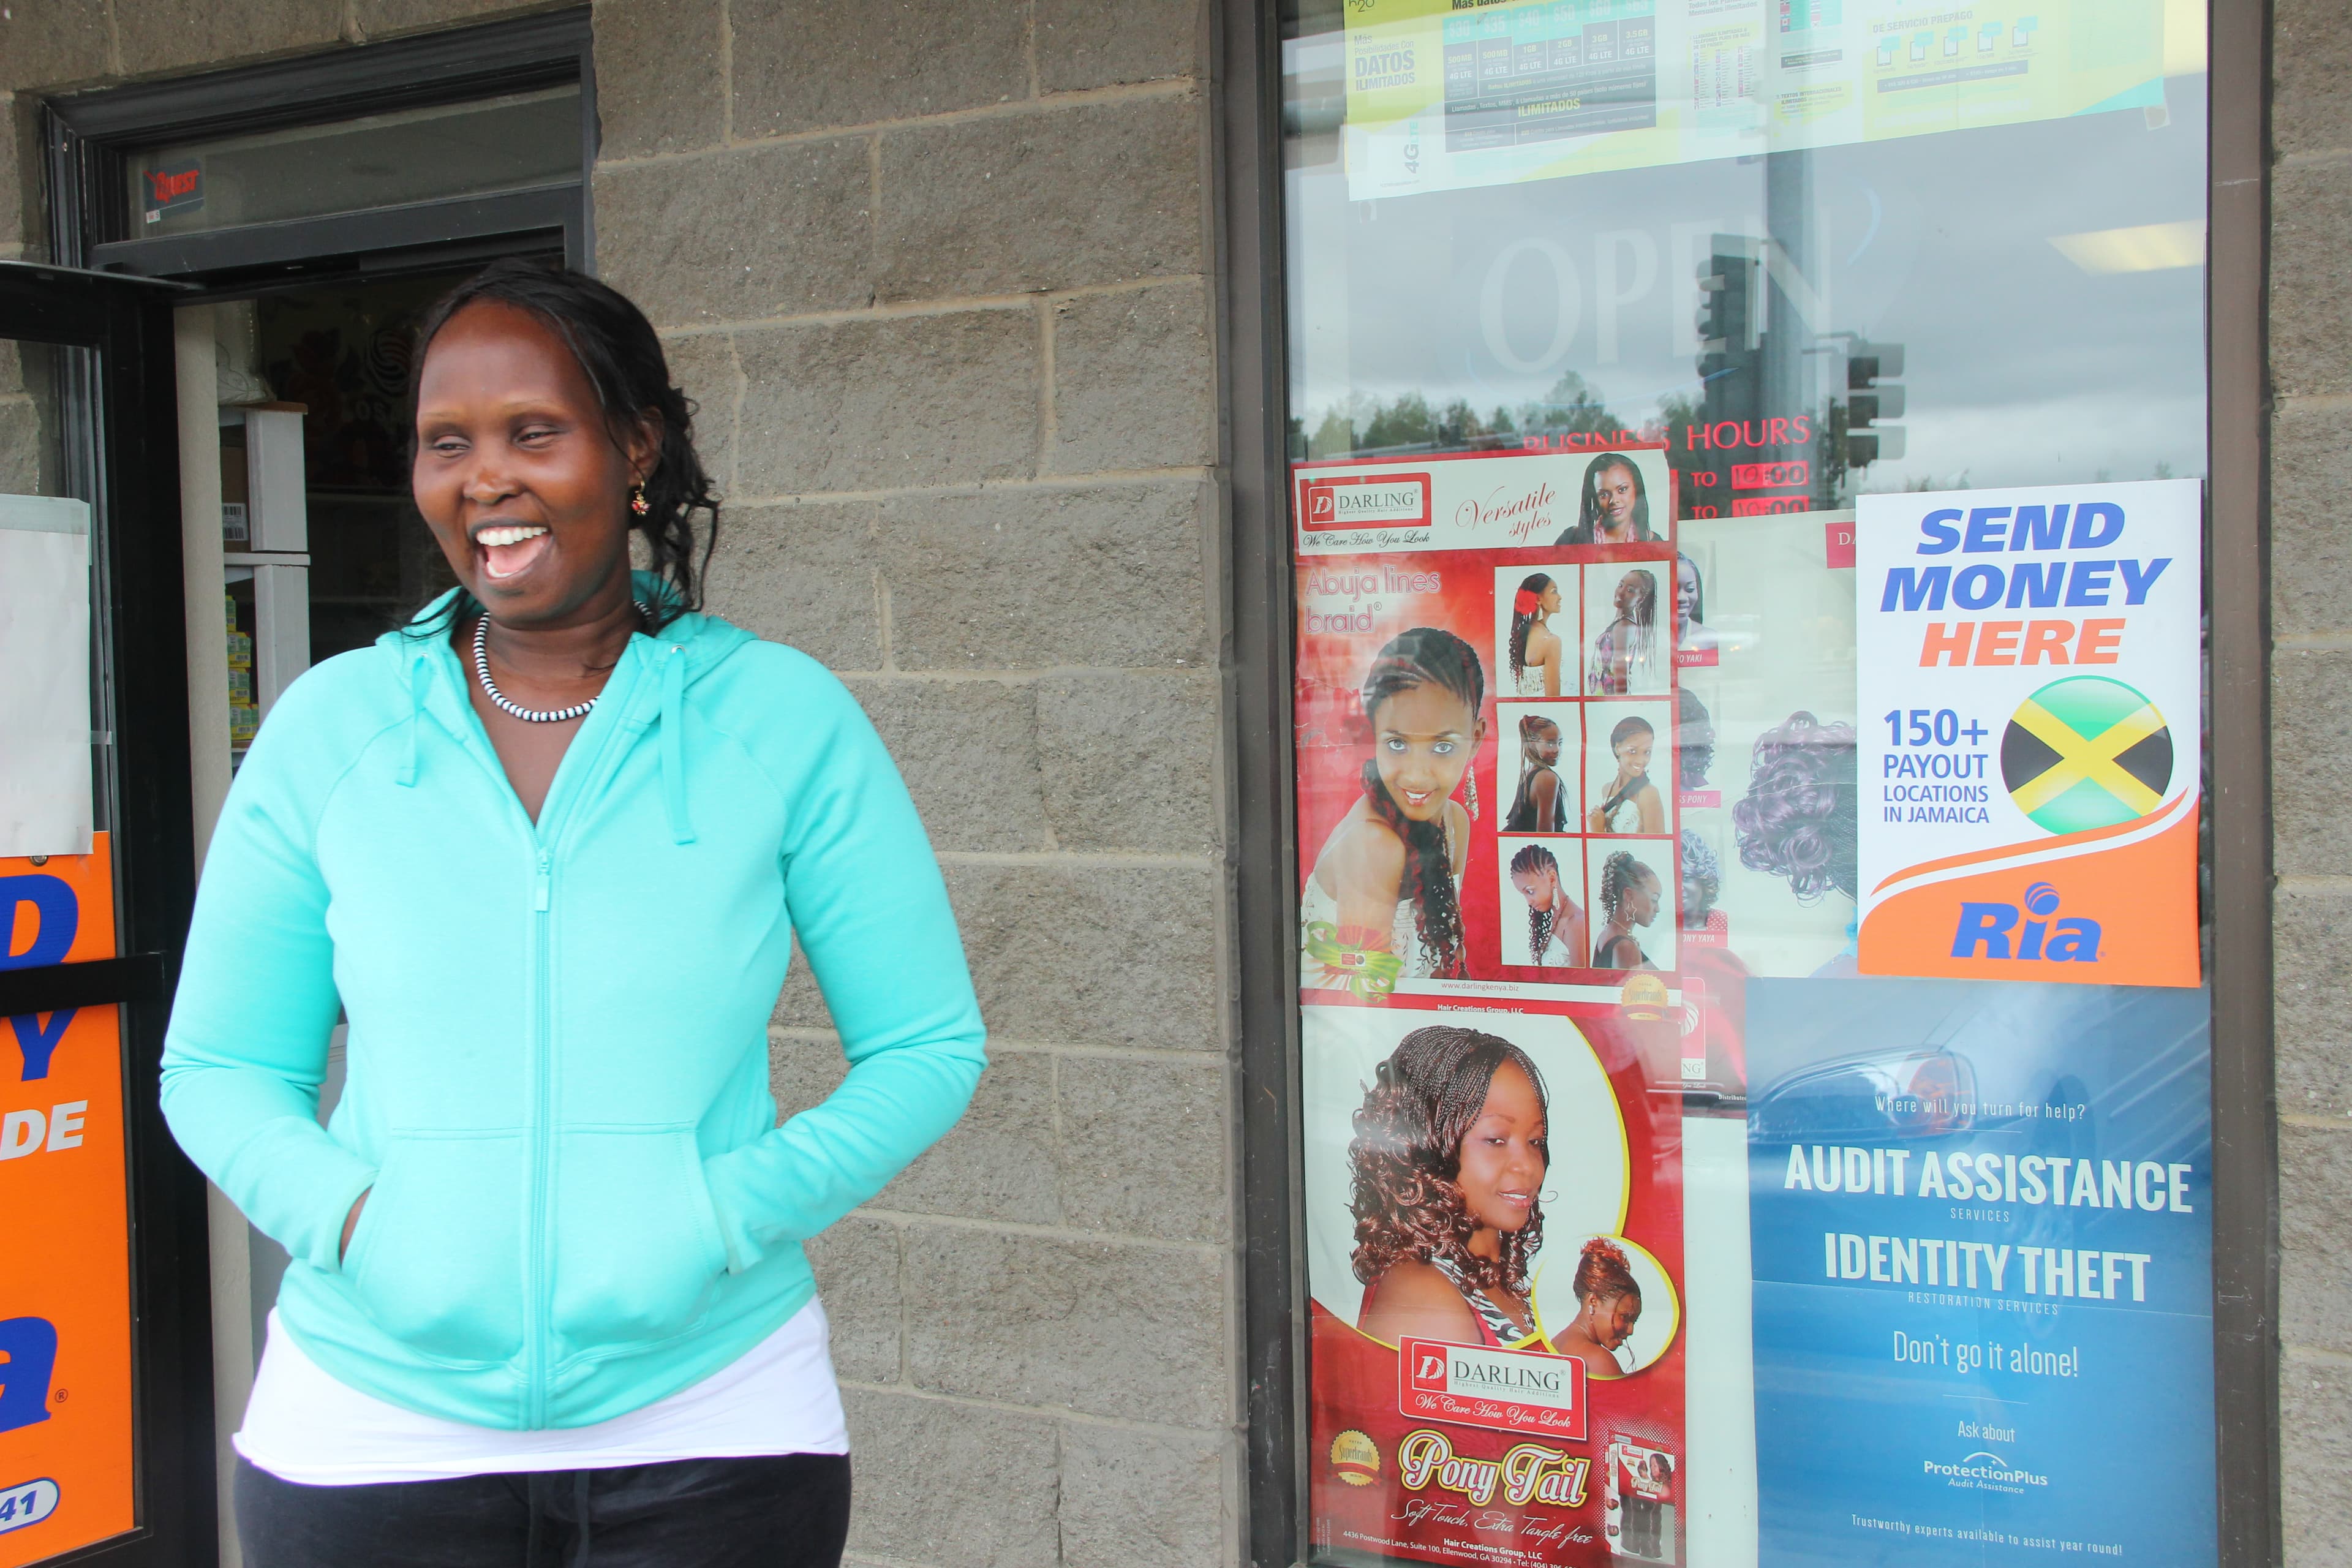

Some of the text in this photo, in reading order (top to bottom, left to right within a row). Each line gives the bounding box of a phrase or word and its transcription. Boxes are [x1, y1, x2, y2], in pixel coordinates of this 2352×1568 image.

[1873, 10, 1973, 33] DE SERVICIO PREPAGO
[1355, 43, 1400, 56] Posibilidades
[1565, 56, 1577, 64] LTE
[1637, 45, 1649, 54] LTE
[1355, 49, 1415, 78] DATOS
[1355, 72, 1415, 91] ILIMITADOS
[1518, 98, 1581, 118] ILIMITADOS
[1479, 208, 1833, 372] OPEN
[1687, 416, 1811, 451] HOURS
[1691, 464, 1805, 487] TO 10:00
[1455, 483, 1556, 531] Versatile
[1692, 505, 1718, 519] TO
[1303, 530, 1430, 548] We Care How You Look
[1509, 510, 1551, 546] styles
[1916, 502, 2125, 556] SEND
[1306, 564, 1441, 602] Abuja lines
[1880, 557, 2174, 612] MONEY
[1918, 617, 2127, 667] HERE
[1883, 709, 1989, 747] 150+
[1883, 753, 1989, 779] PAYOUT
[1687, 794, 1708, 804] PONY
[1883, 785, 1989, 802] LOCATIONS
[1883, 806, 1990, 823] IN JAMAICA
[1950, 881, 2102, 963] Ria
[1698, 933, 1715, 943] YAYA
[1441, 982, 1520, 992] www.darlingkenya.biz
[1875, 1096, 2086, 1122] Where will you turn for help?
[1784, 1144, 2193, 1213] AUDIT ASSISTANCE
[1950, 1208, 2010, 1223] SERVICES
[1825, 1232, 2150, 1302] IDENTITY THEFT
[1908, 1291, 2059, 1315] RESTORATION SERVICES
[1893, 1330, 2078, 1377] Don't go it alone!
[1481, 1384, 1506, 1392] Quality
[1526, 1389, 1559, 1398] Additions
[1415, 1393, 1571, 1428] We Care How You Look
[1958, 1420, 2015, 1443] Ask about
[1338, 1444, 1373, 1463] Superbrands
[1399, 1430, 1591, 1507] Pony Tail
[1923, 1460, 2048, 1486] ProtectionPlus
[1948, 1478, 2024, 1494] Audit Assistance
[1390, 1499, 1593, 1549] Soft Touch, Extra Tangle free
[1852, 1514, 2122, 1556] Trustworthy experts available to assist year round!
[1343, 1531, 1359, 1539] 4436
[1360, 1533, 1390, 1545] Postwood
[1391, 1539, 1409, 1549] Lane,
[1410, 1542, 1427, 1551] Suite
[1428, 1545, 1441, 1554] 100,
[1442, 1547, 1479, 1560] Ellenwood,
[1480, 1553, 1490, 1561] GA
[1491, 1555, 1512, 1564] 30294
[1517, 1559, 1529, 1568] Tel:
[1444, 1538, 1542, 1560] Hair Creations Group, LLC
